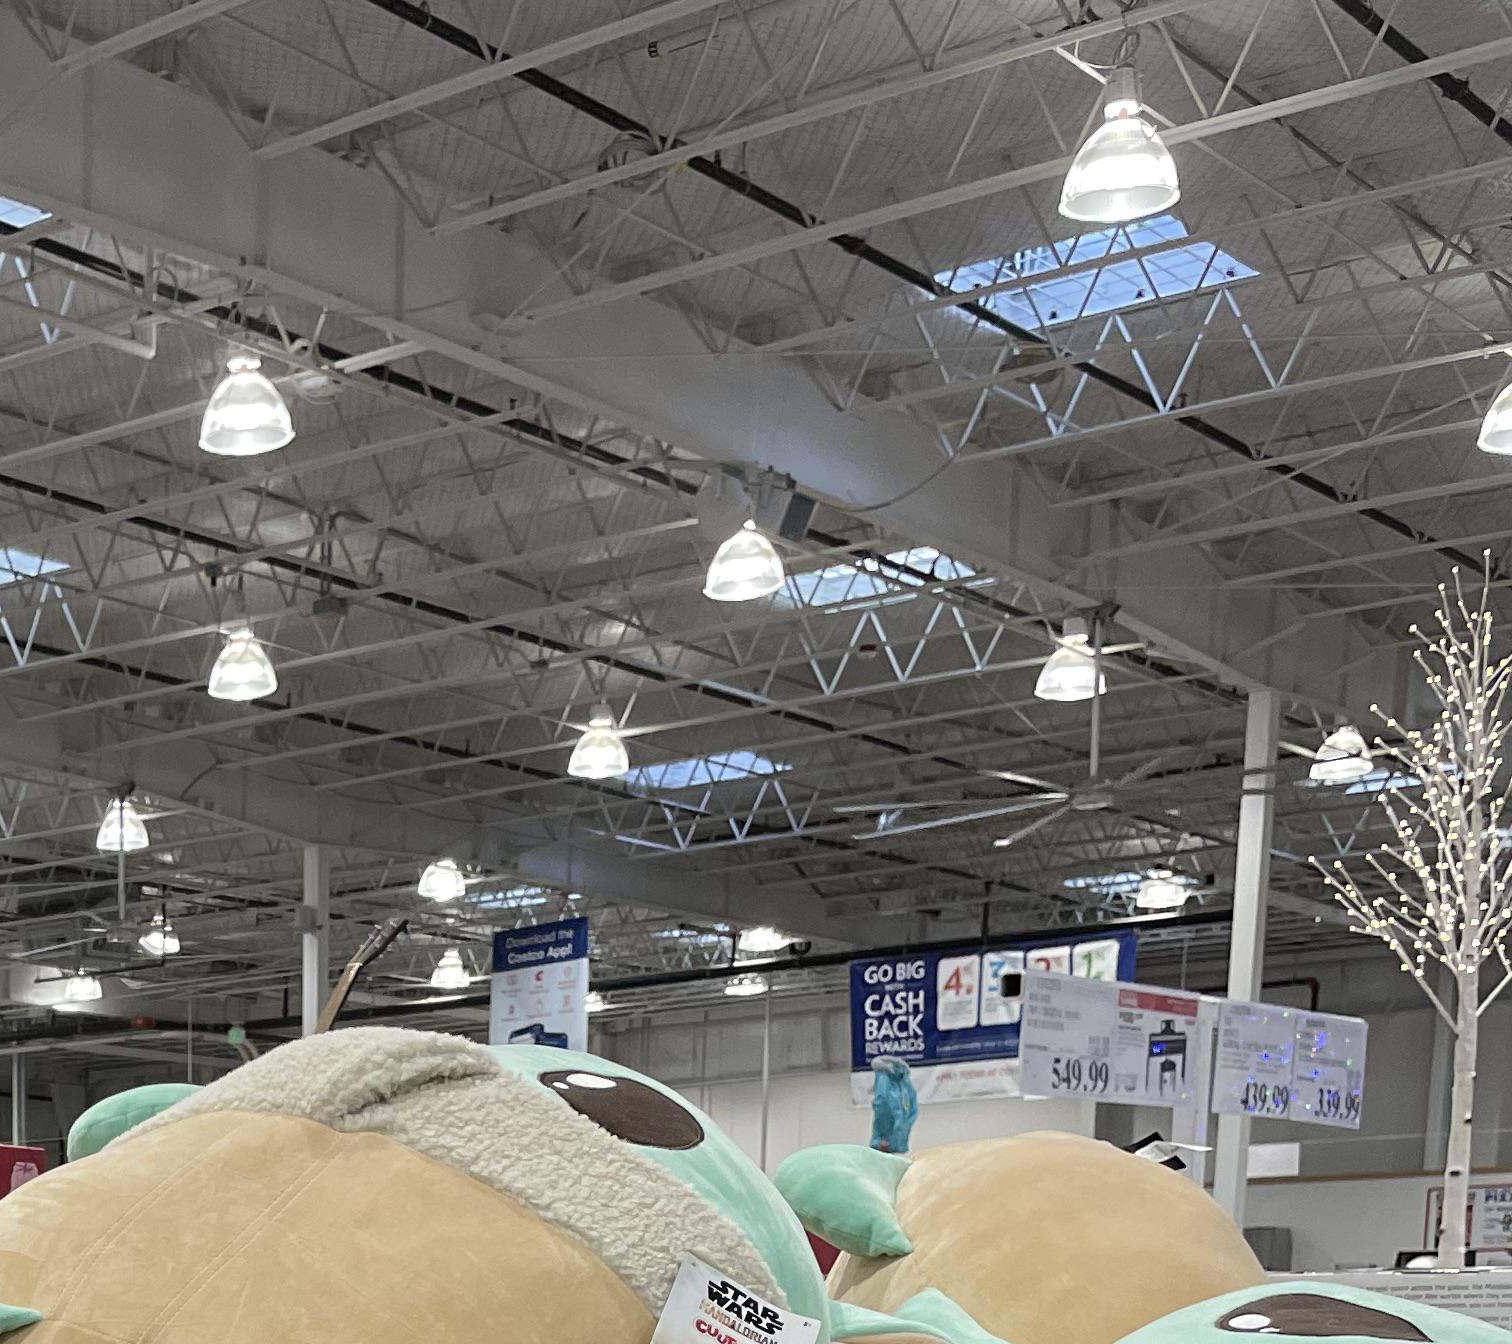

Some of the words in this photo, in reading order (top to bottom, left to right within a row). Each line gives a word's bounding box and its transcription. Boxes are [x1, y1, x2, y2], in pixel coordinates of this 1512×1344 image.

[863, 965, 894, 985] GO
[896, 959, 926, 982] BIG
[864, 989, 925, 1018] CASH
[864, 1013, 924, 1040] BACK
[707, 1285, 783, 1335] WARS
[708, 1280, 785, 1327] STAR
